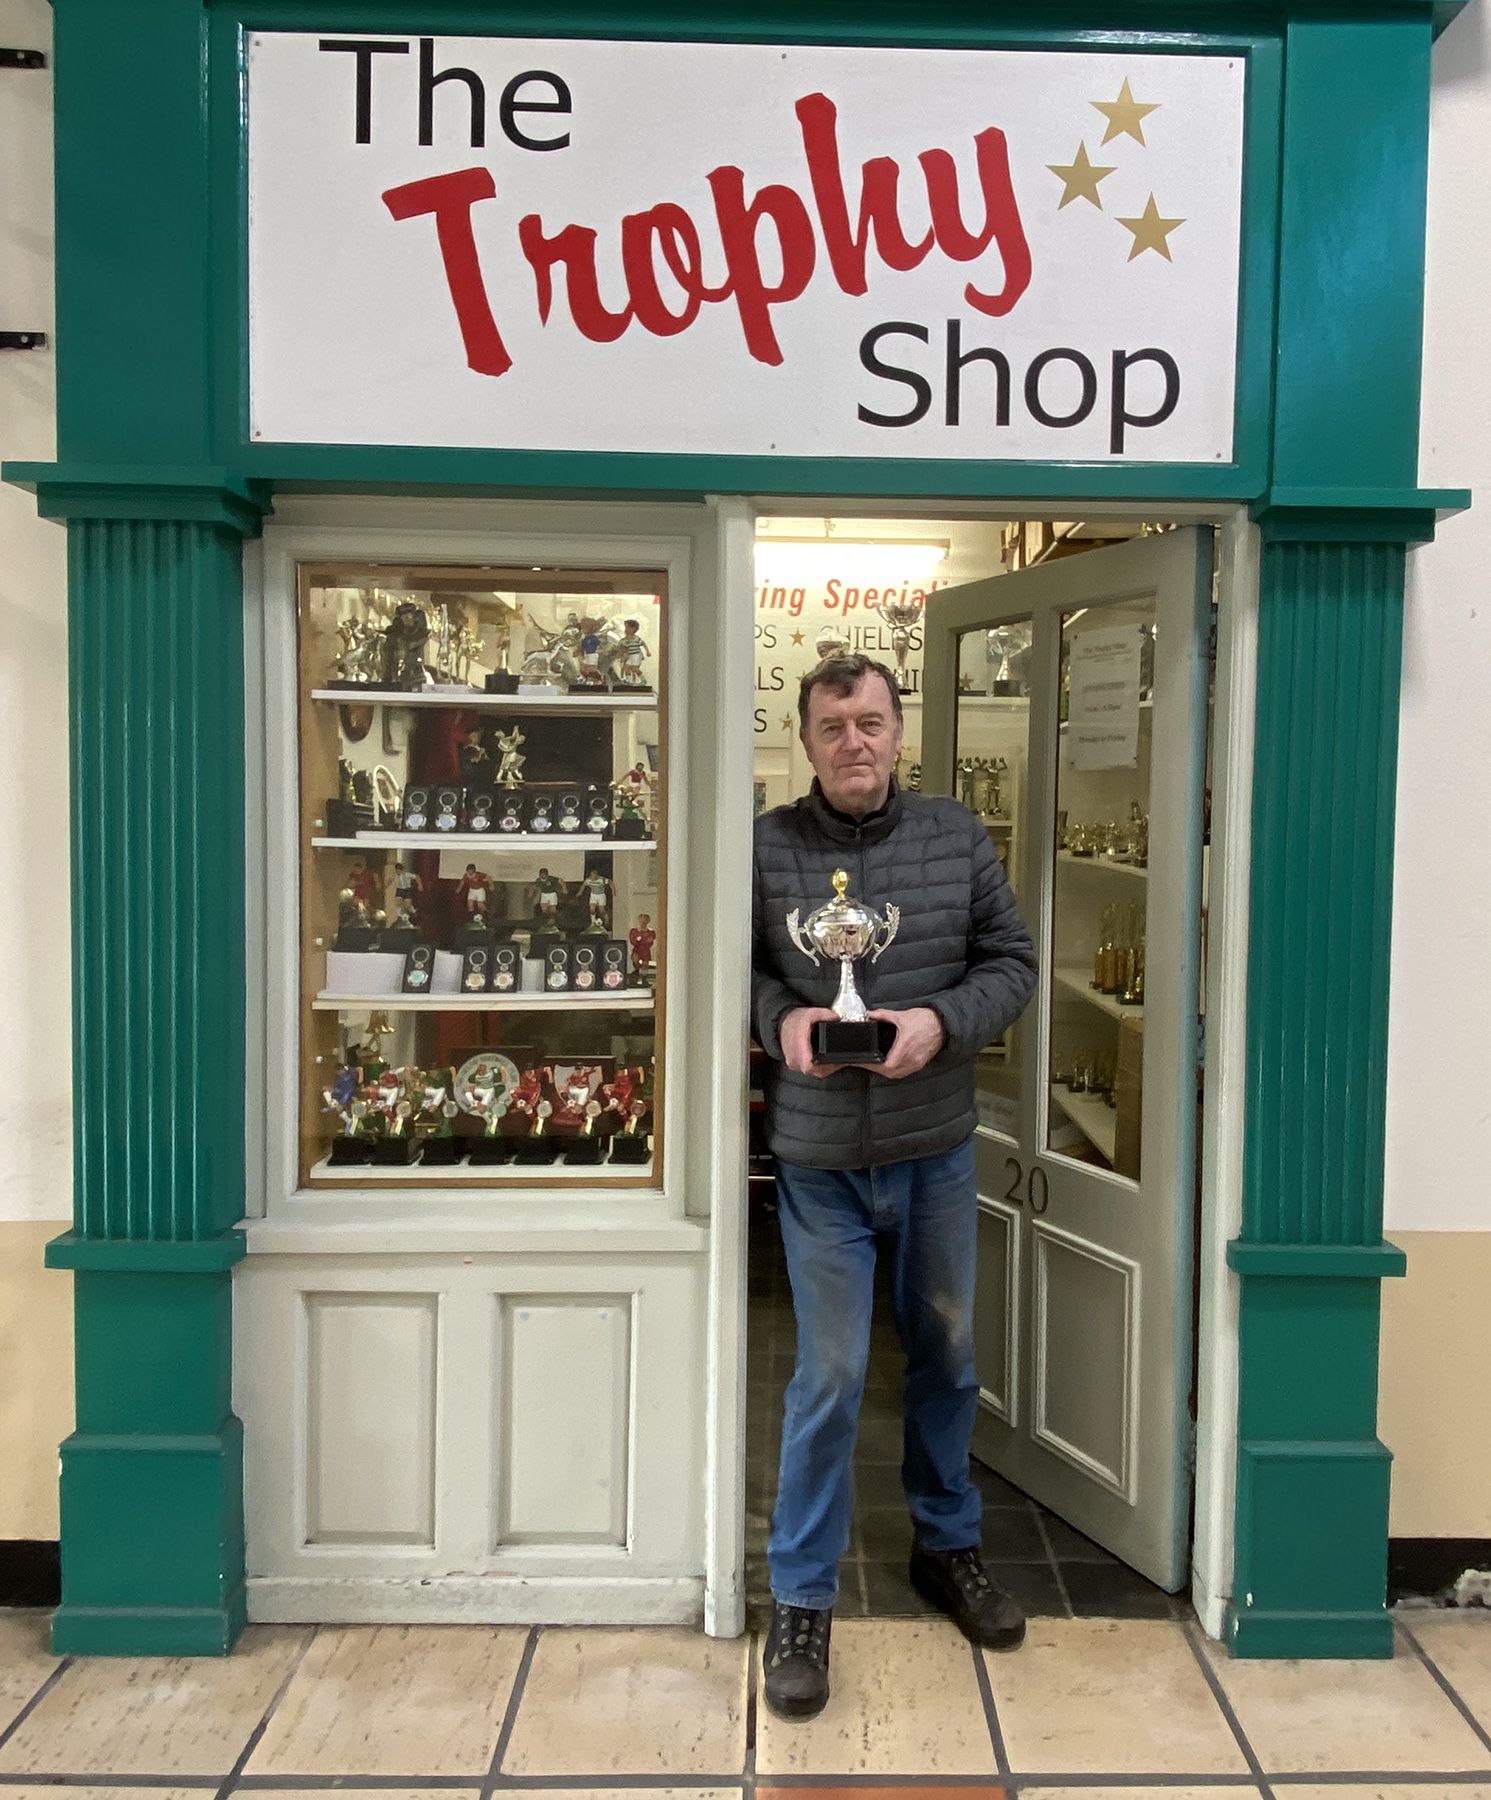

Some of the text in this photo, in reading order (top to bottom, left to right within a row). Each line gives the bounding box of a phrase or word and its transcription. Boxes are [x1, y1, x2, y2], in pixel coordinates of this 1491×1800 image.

[319, 38, 572, 151] The
[381, 92, 1033, 376] Trophy
[857, 319, 1181, 454] Shop
[754, 579, 948, 617] ing Specia
[755, 666, 785, 691] LS
[1004, 1157, 1048, 1214] 20
